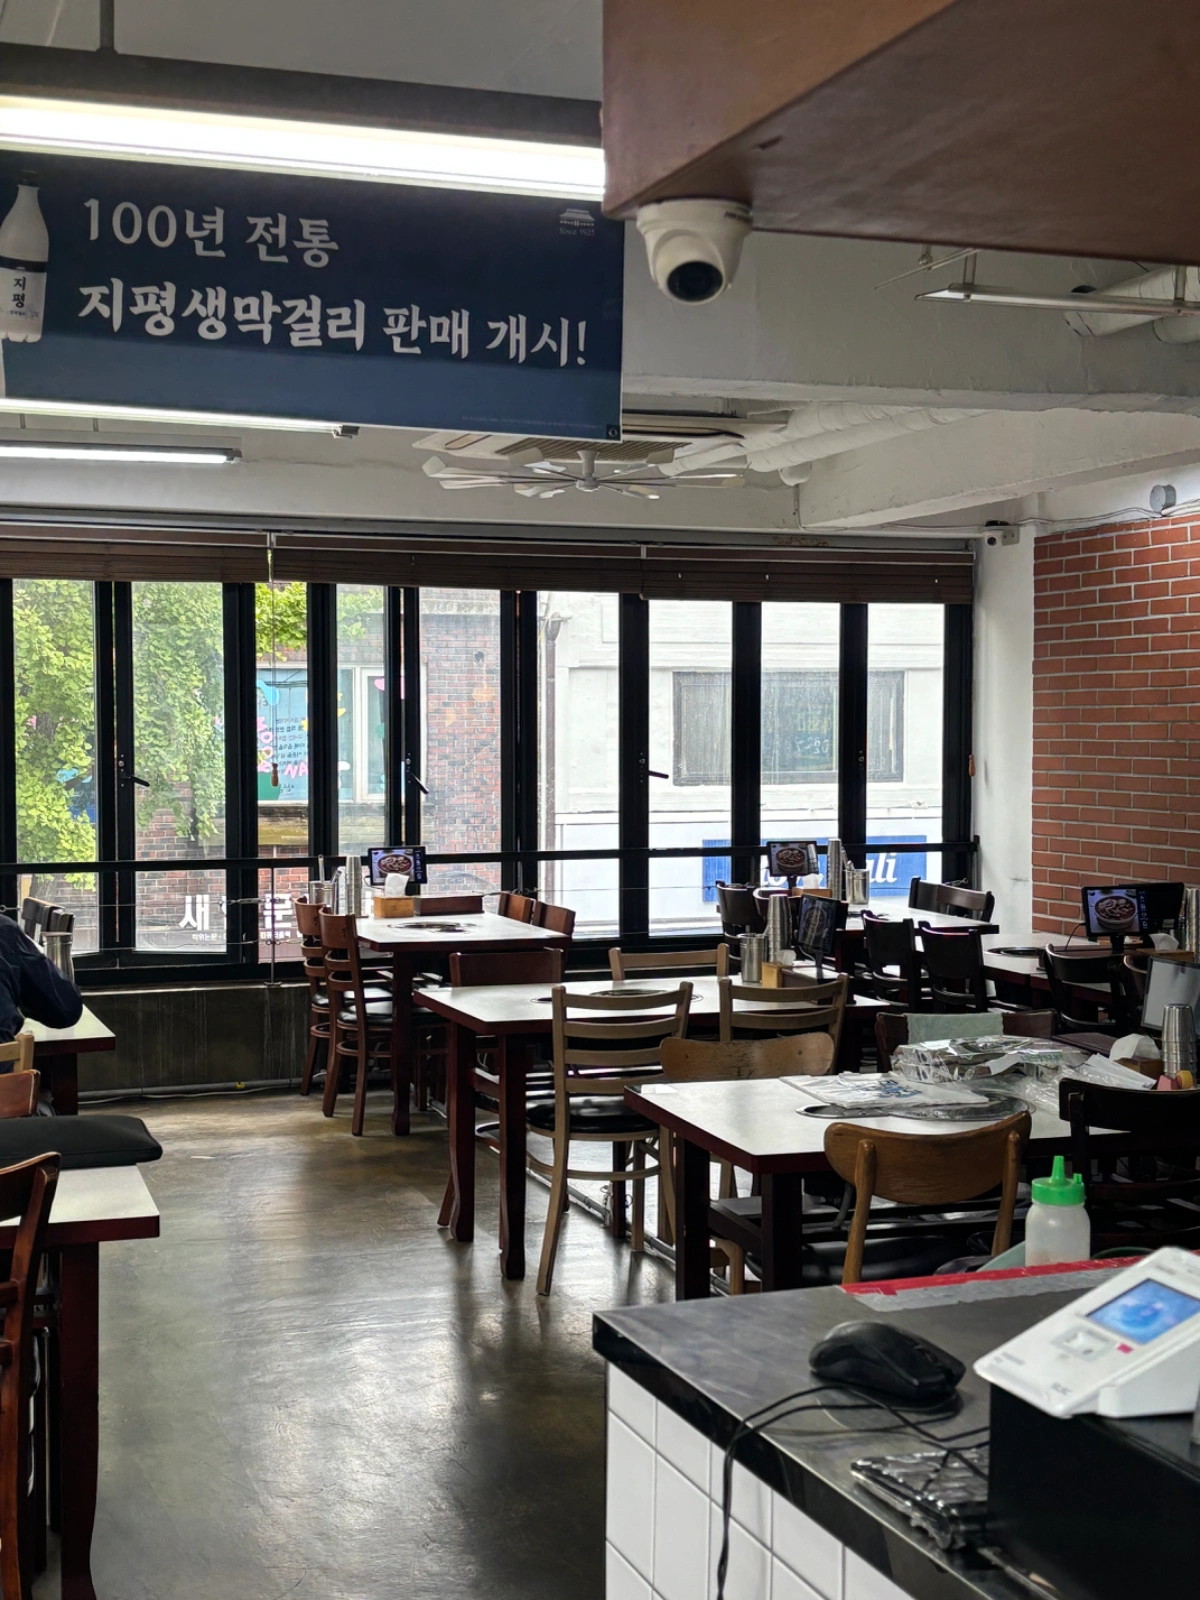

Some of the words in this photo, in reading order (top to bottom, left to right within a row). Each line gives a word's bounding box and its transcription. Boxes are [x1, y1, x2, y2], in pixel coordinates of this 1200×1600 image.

[84, 198, 227, 258] 100년
[245, 213, 340, 269] 전통
[12, 276, 27, 309] 지평
[79, 277, 366, 352] 지평생막걸리
[381, 304, 470, 360] 판매
[486, 314, 587, 368] 개시!
